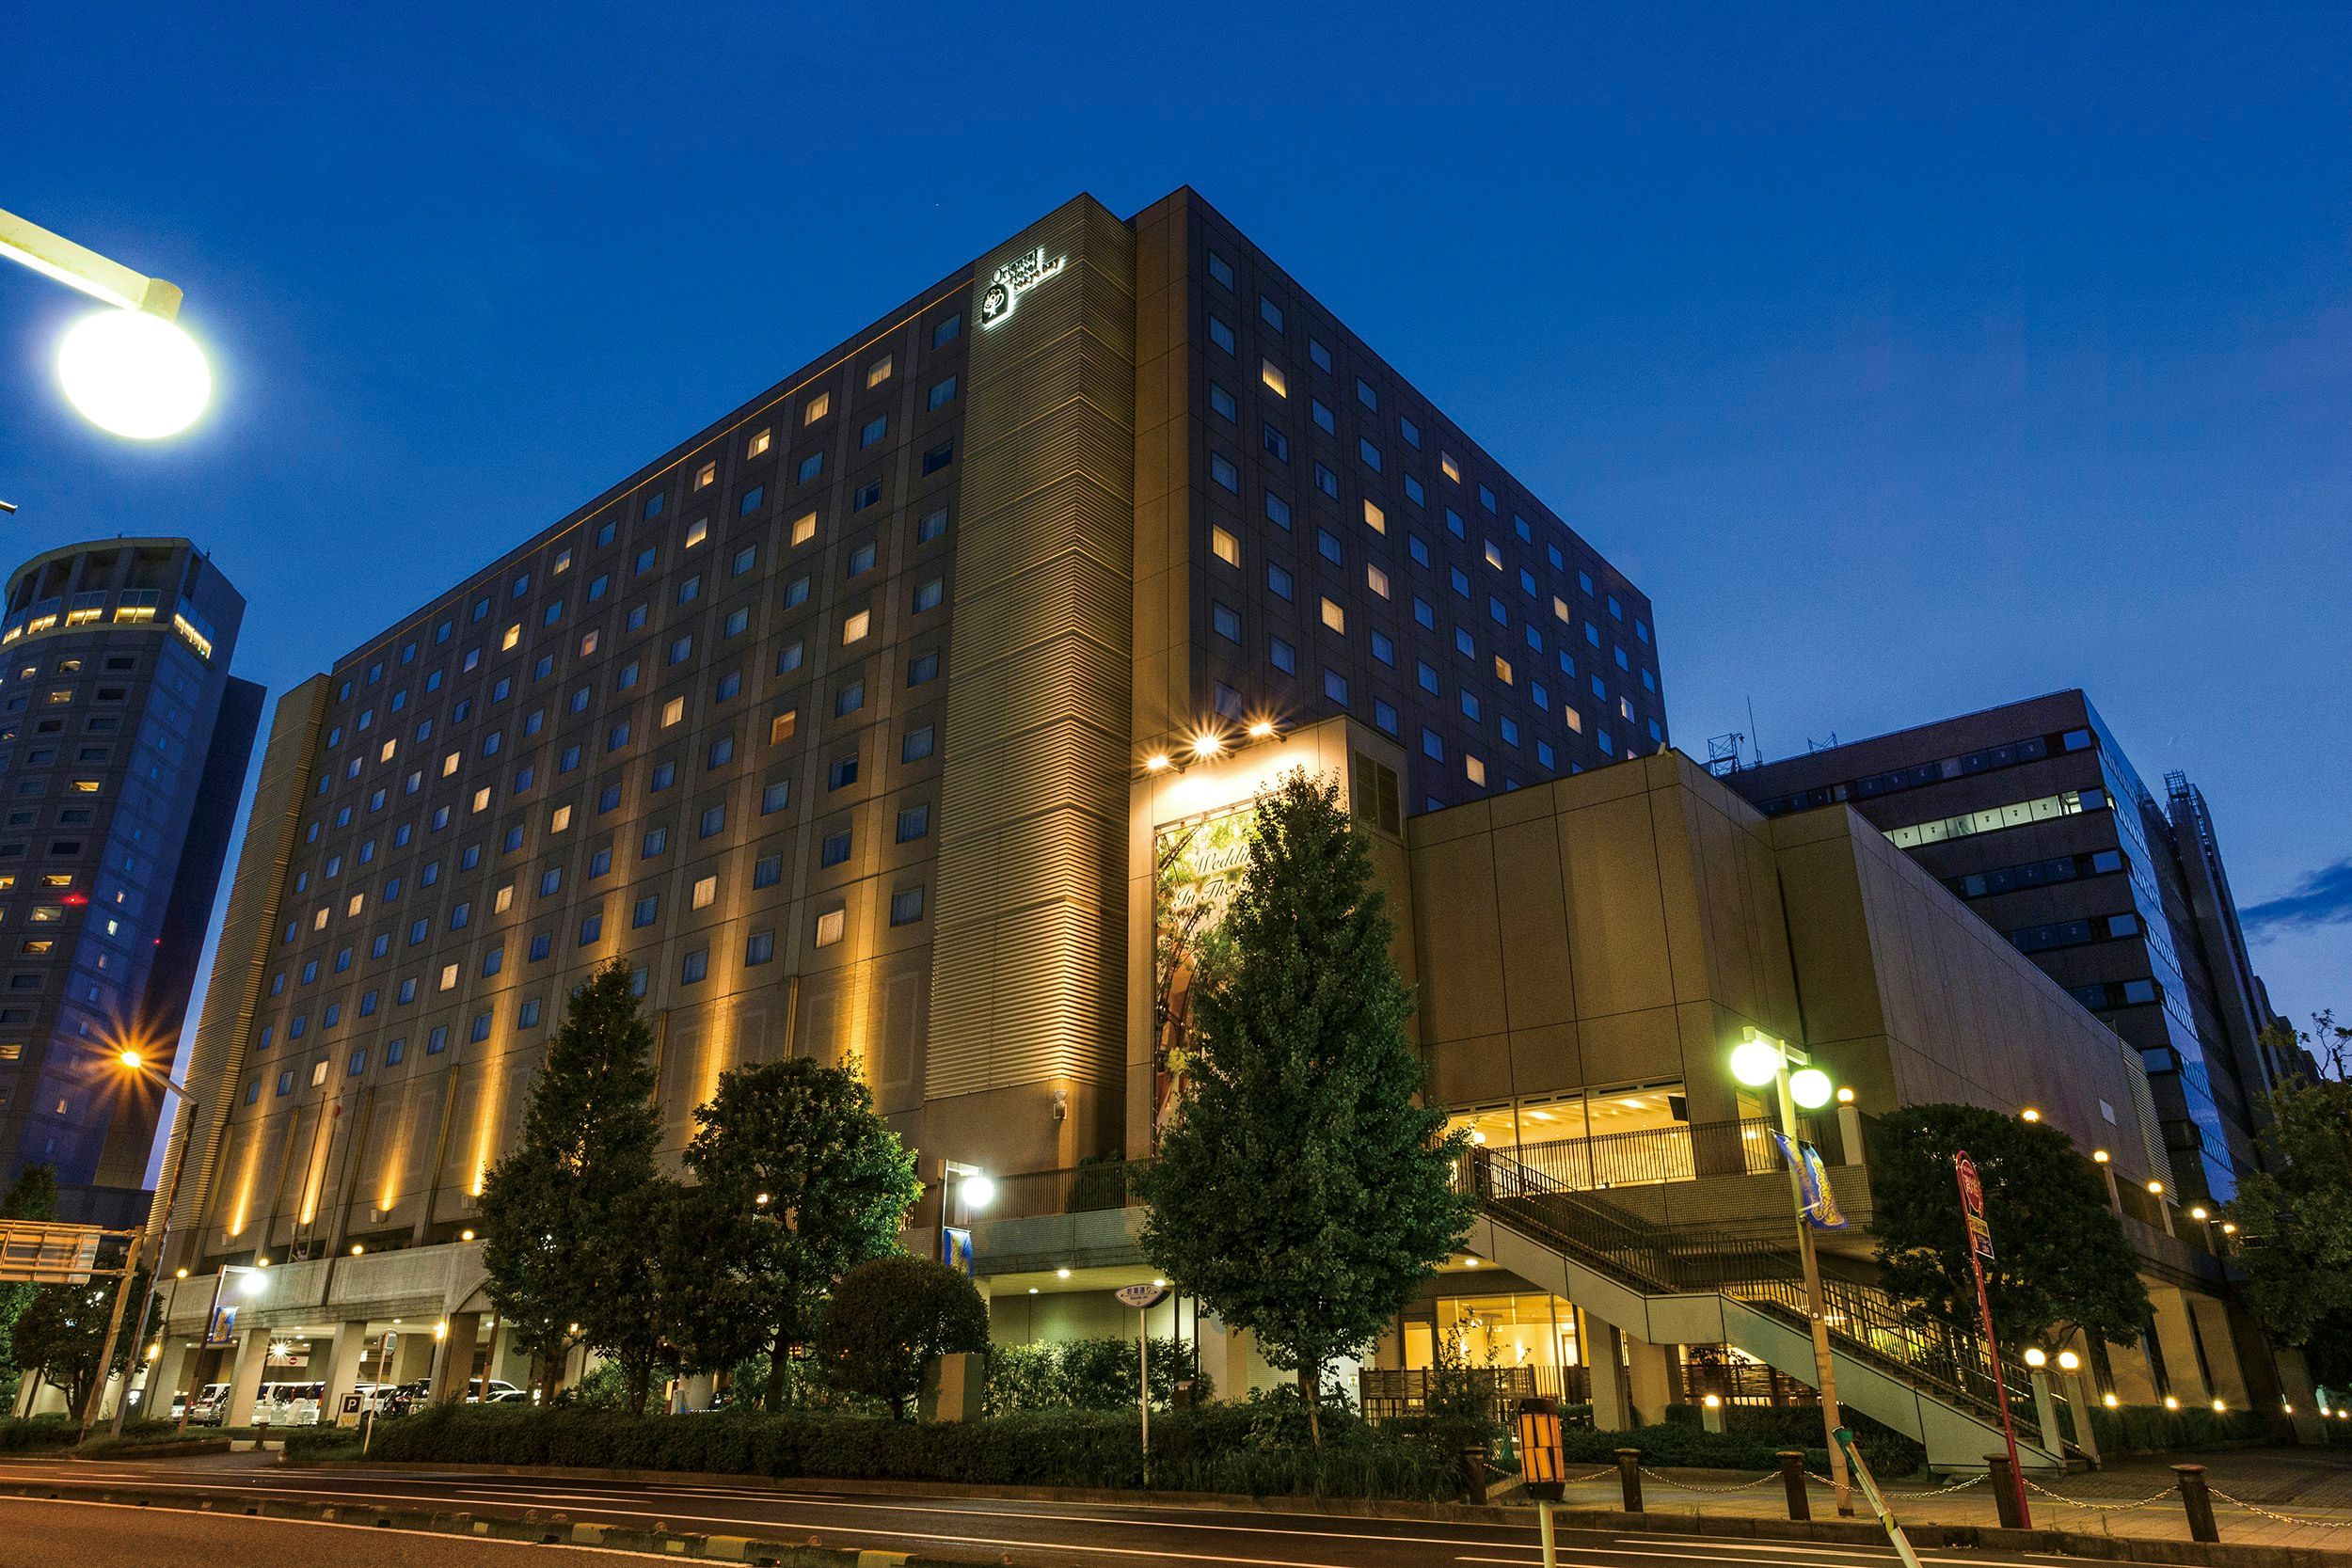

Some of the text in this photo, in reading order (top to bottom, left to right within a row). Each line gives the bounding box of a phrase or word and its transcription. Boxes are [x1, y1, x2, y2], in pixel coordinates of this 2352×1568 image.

[1194, 845, 1251, 875] Weddi
[1173, 887, 1196, 908] In
[1200, 879, 1236, 901] The
[347, 1399, 358, 1411] P
